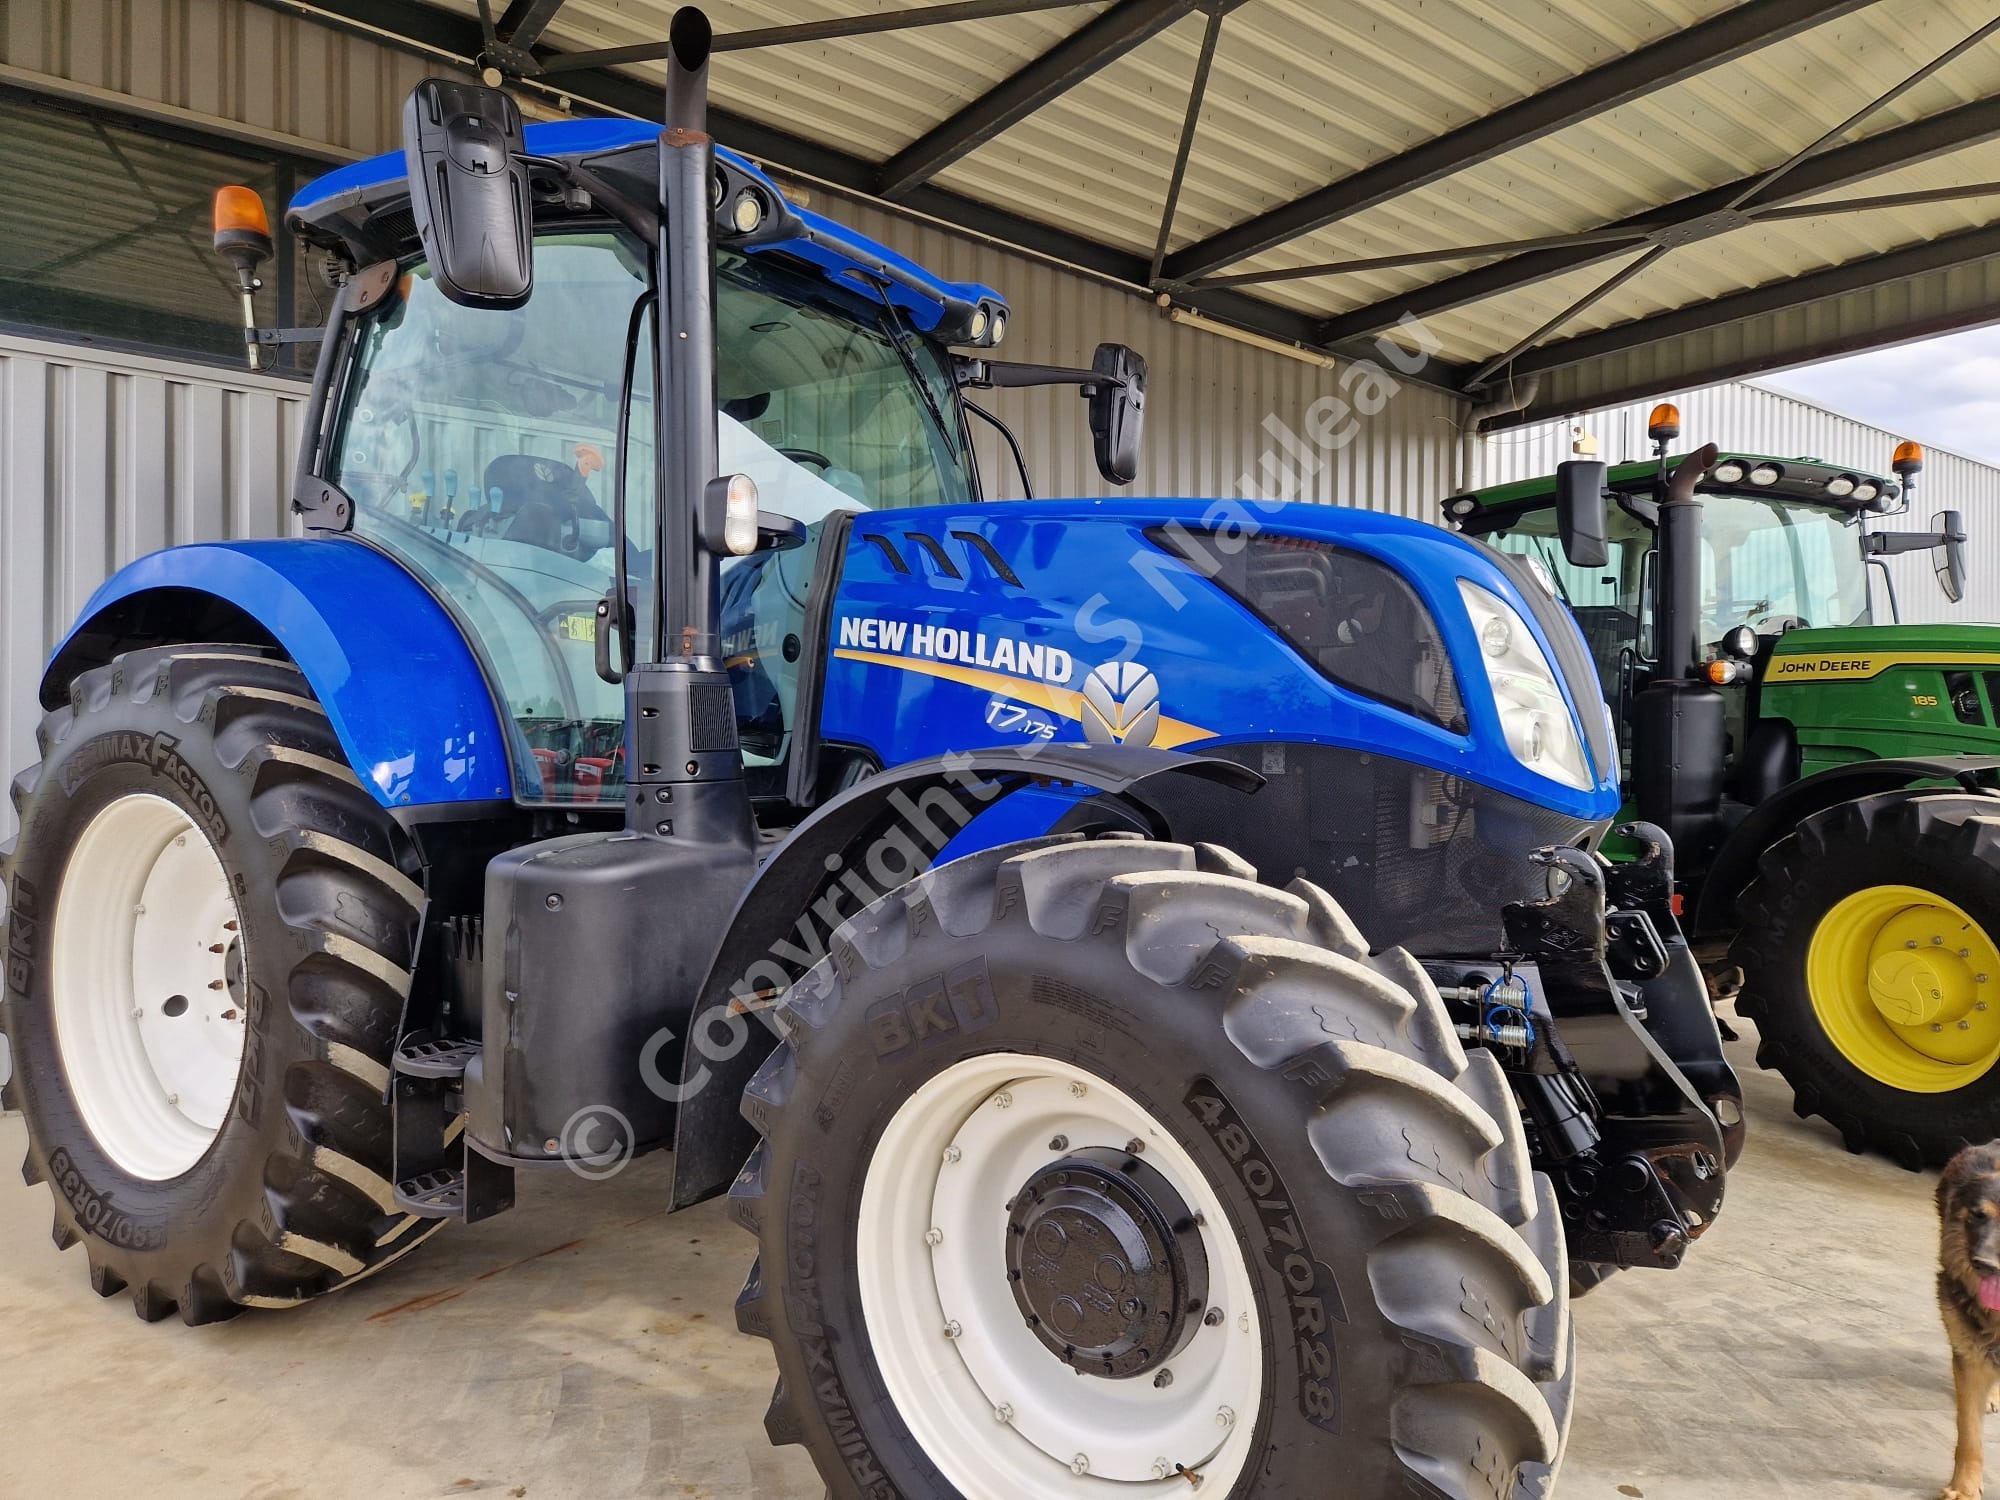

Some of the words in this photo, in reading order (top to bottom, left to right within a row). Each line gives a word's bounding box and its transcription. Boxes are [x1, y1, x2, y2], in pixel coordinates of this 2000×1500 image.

[840, 616, 907, 651] NEW
[912, 623, 1073, 683] HOLLAND
[1778, 661, 1816, 673] JOHN
[1819, 660, 1871, 672] DEERE
[1912, 695, 1938, 706] 185
[8, 874, 34, 994] BKT
[870, 973, 985, 1054] BKT
[1190, 1096, 1336, 1422] 480/70R28
